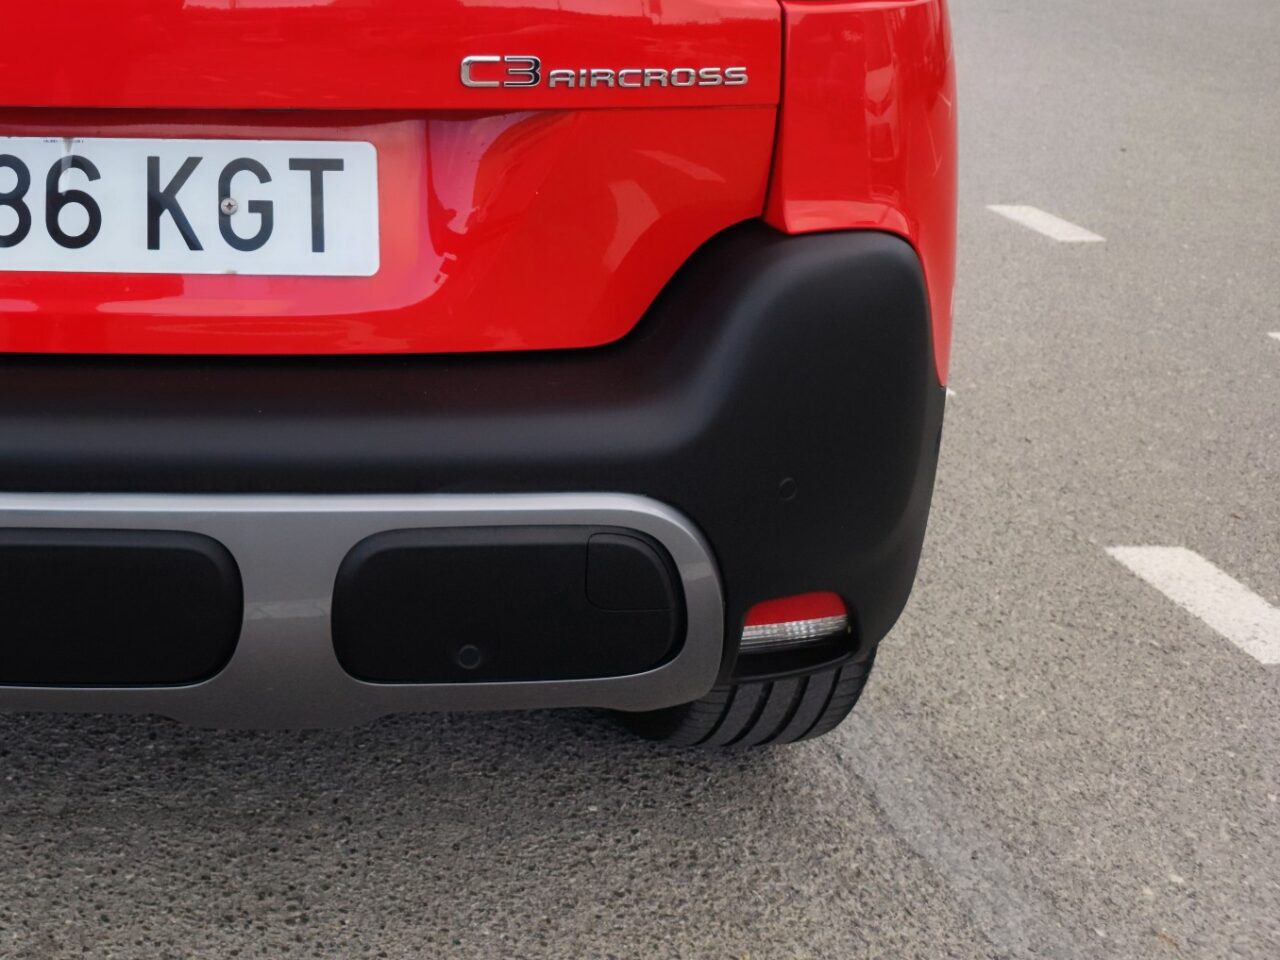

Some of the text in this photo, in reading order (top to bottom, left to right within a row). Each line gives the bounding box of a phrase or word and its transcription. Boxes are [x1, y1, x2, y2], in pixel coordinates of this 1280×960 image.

[460, 55, 748, 88] C3 AIRCROSS
[146, 155, 345, 253] KGT
